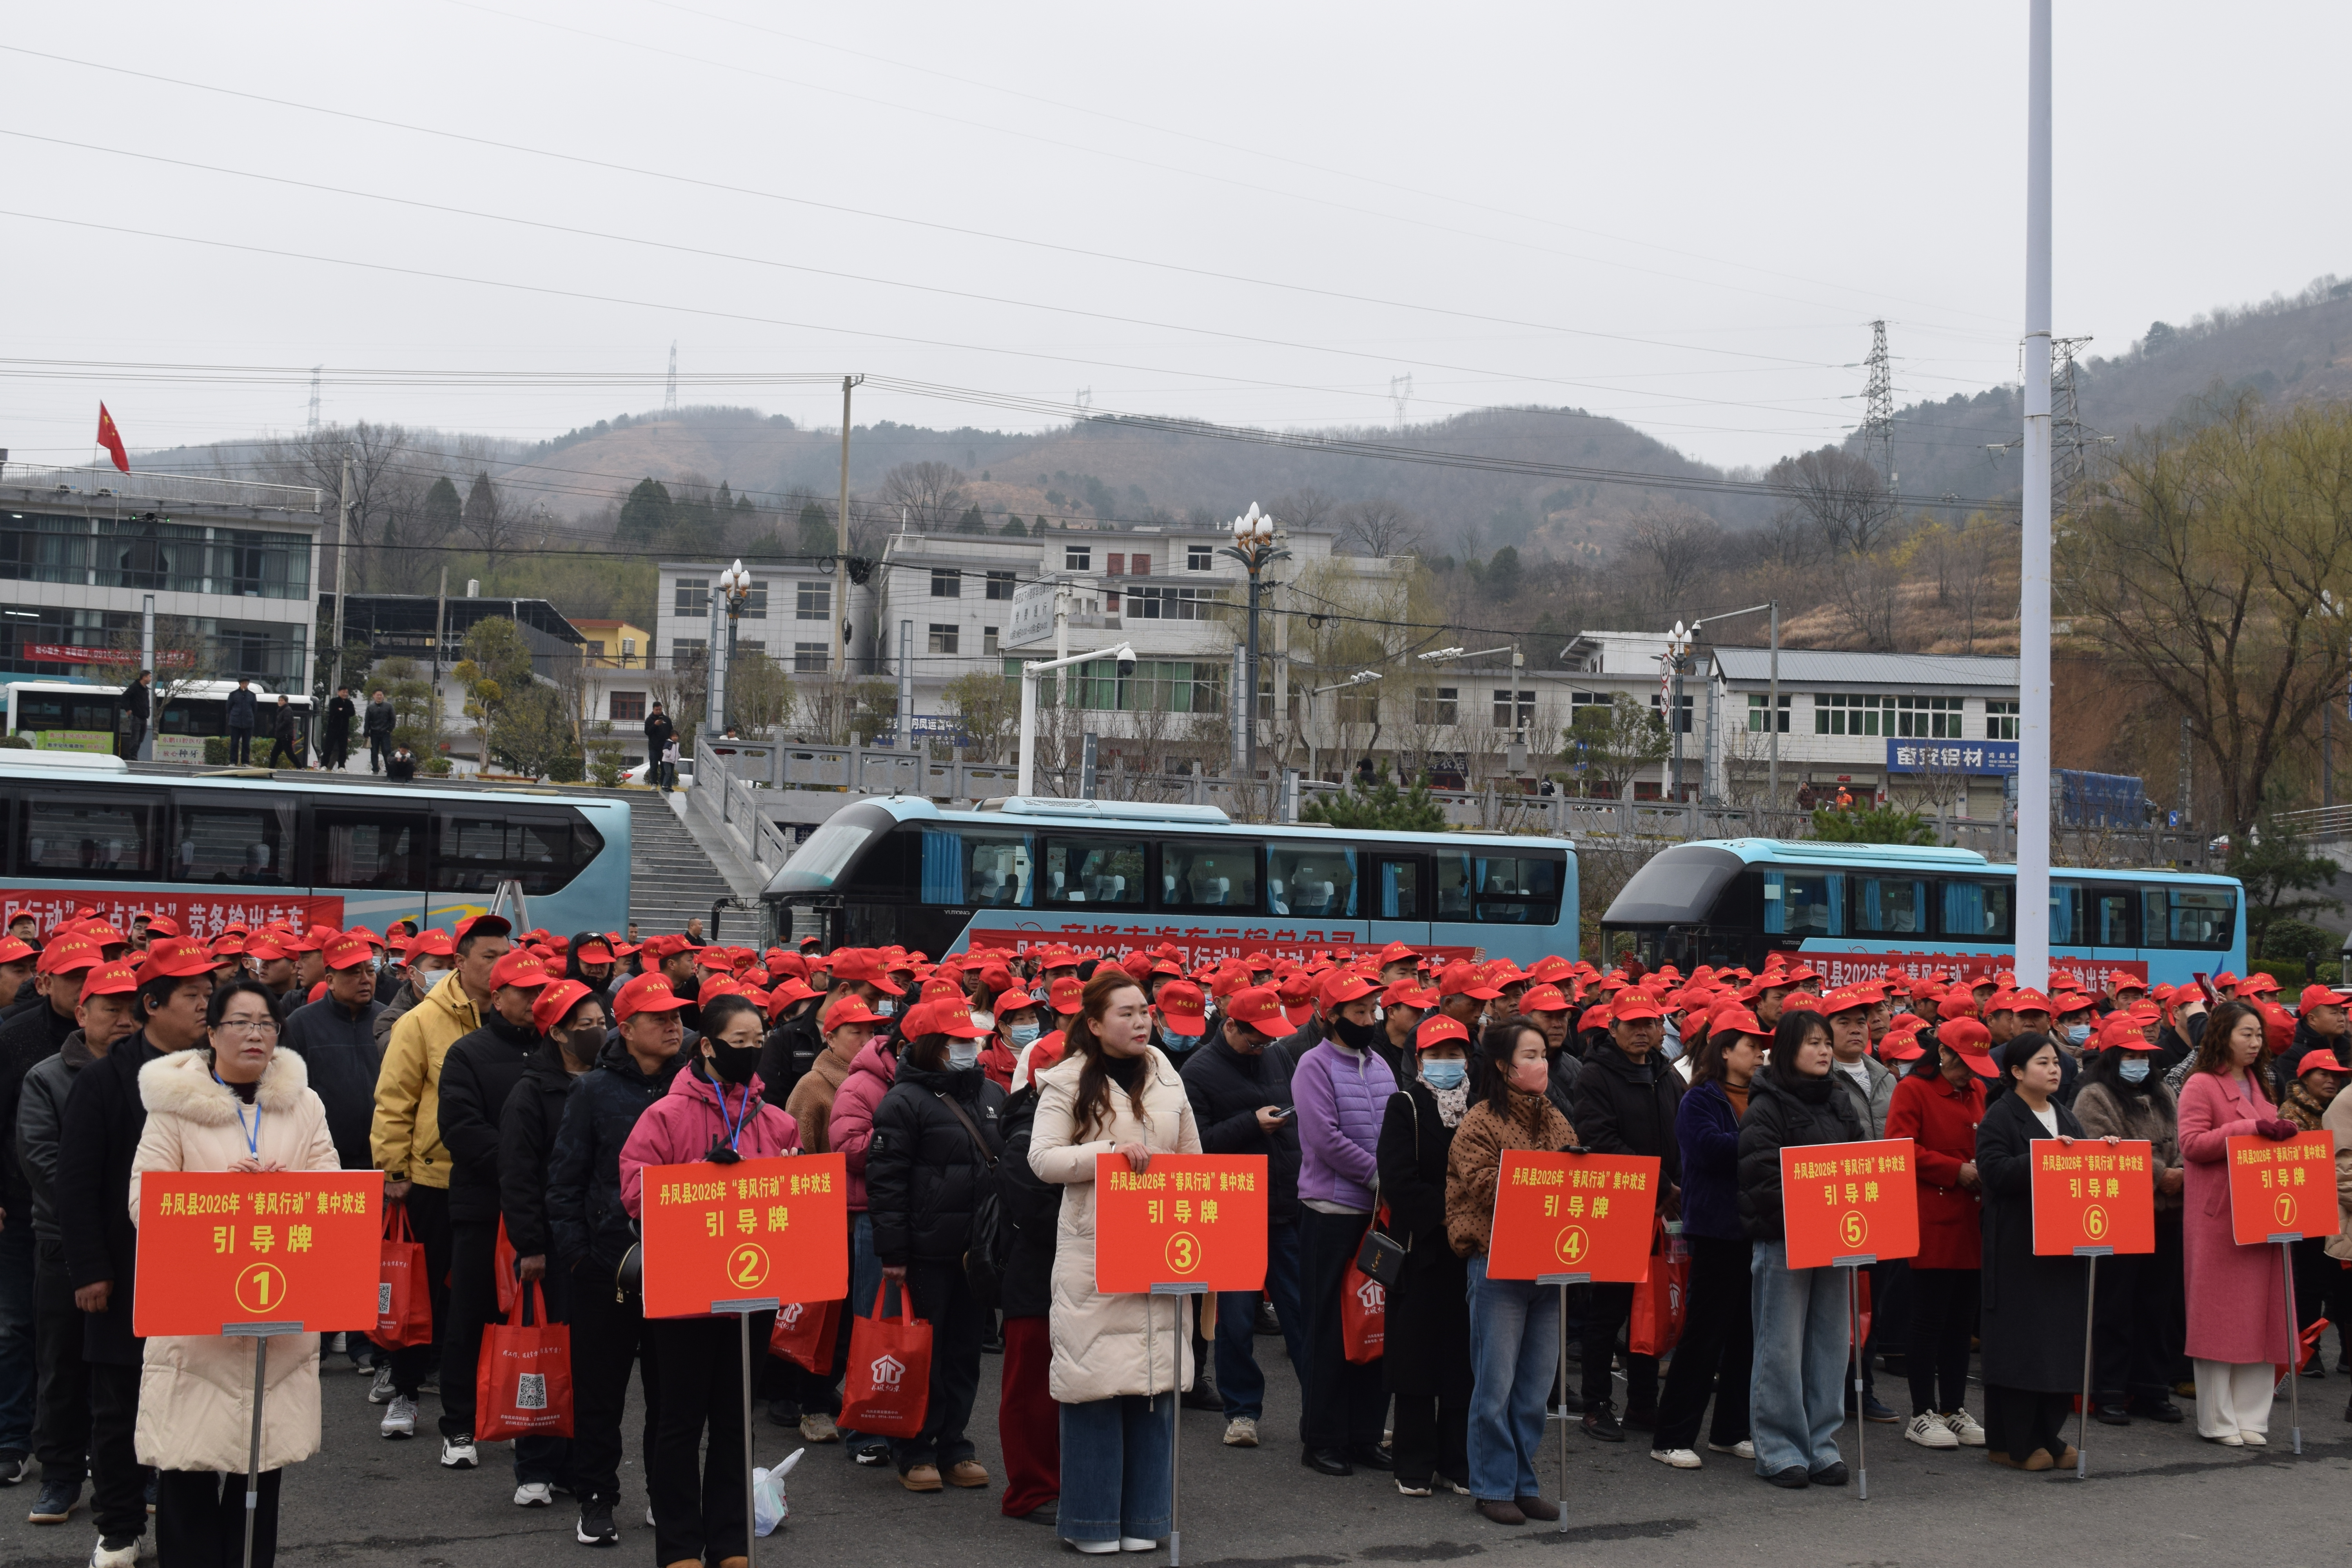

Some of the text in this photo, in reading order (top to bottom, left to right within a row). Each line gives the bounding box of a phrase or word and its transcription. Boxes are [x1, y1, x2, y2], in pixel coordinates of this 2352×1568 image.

[1662, 661, 1668, 676] 20
[2069, 1178, 2119, 1198] 引导牌
[2261, 1167, 2305, 1189] 引导牌
[1824, 1181, 1879, 1205] 引导牌
[1148, 1199, 1218, 1223] 引导牌
[1544, 1194, 1609, 1219] 引导牌
[706, 1206, 789, 1237] 引导牌
[214, 1225, 312, 1253] 引导牌
